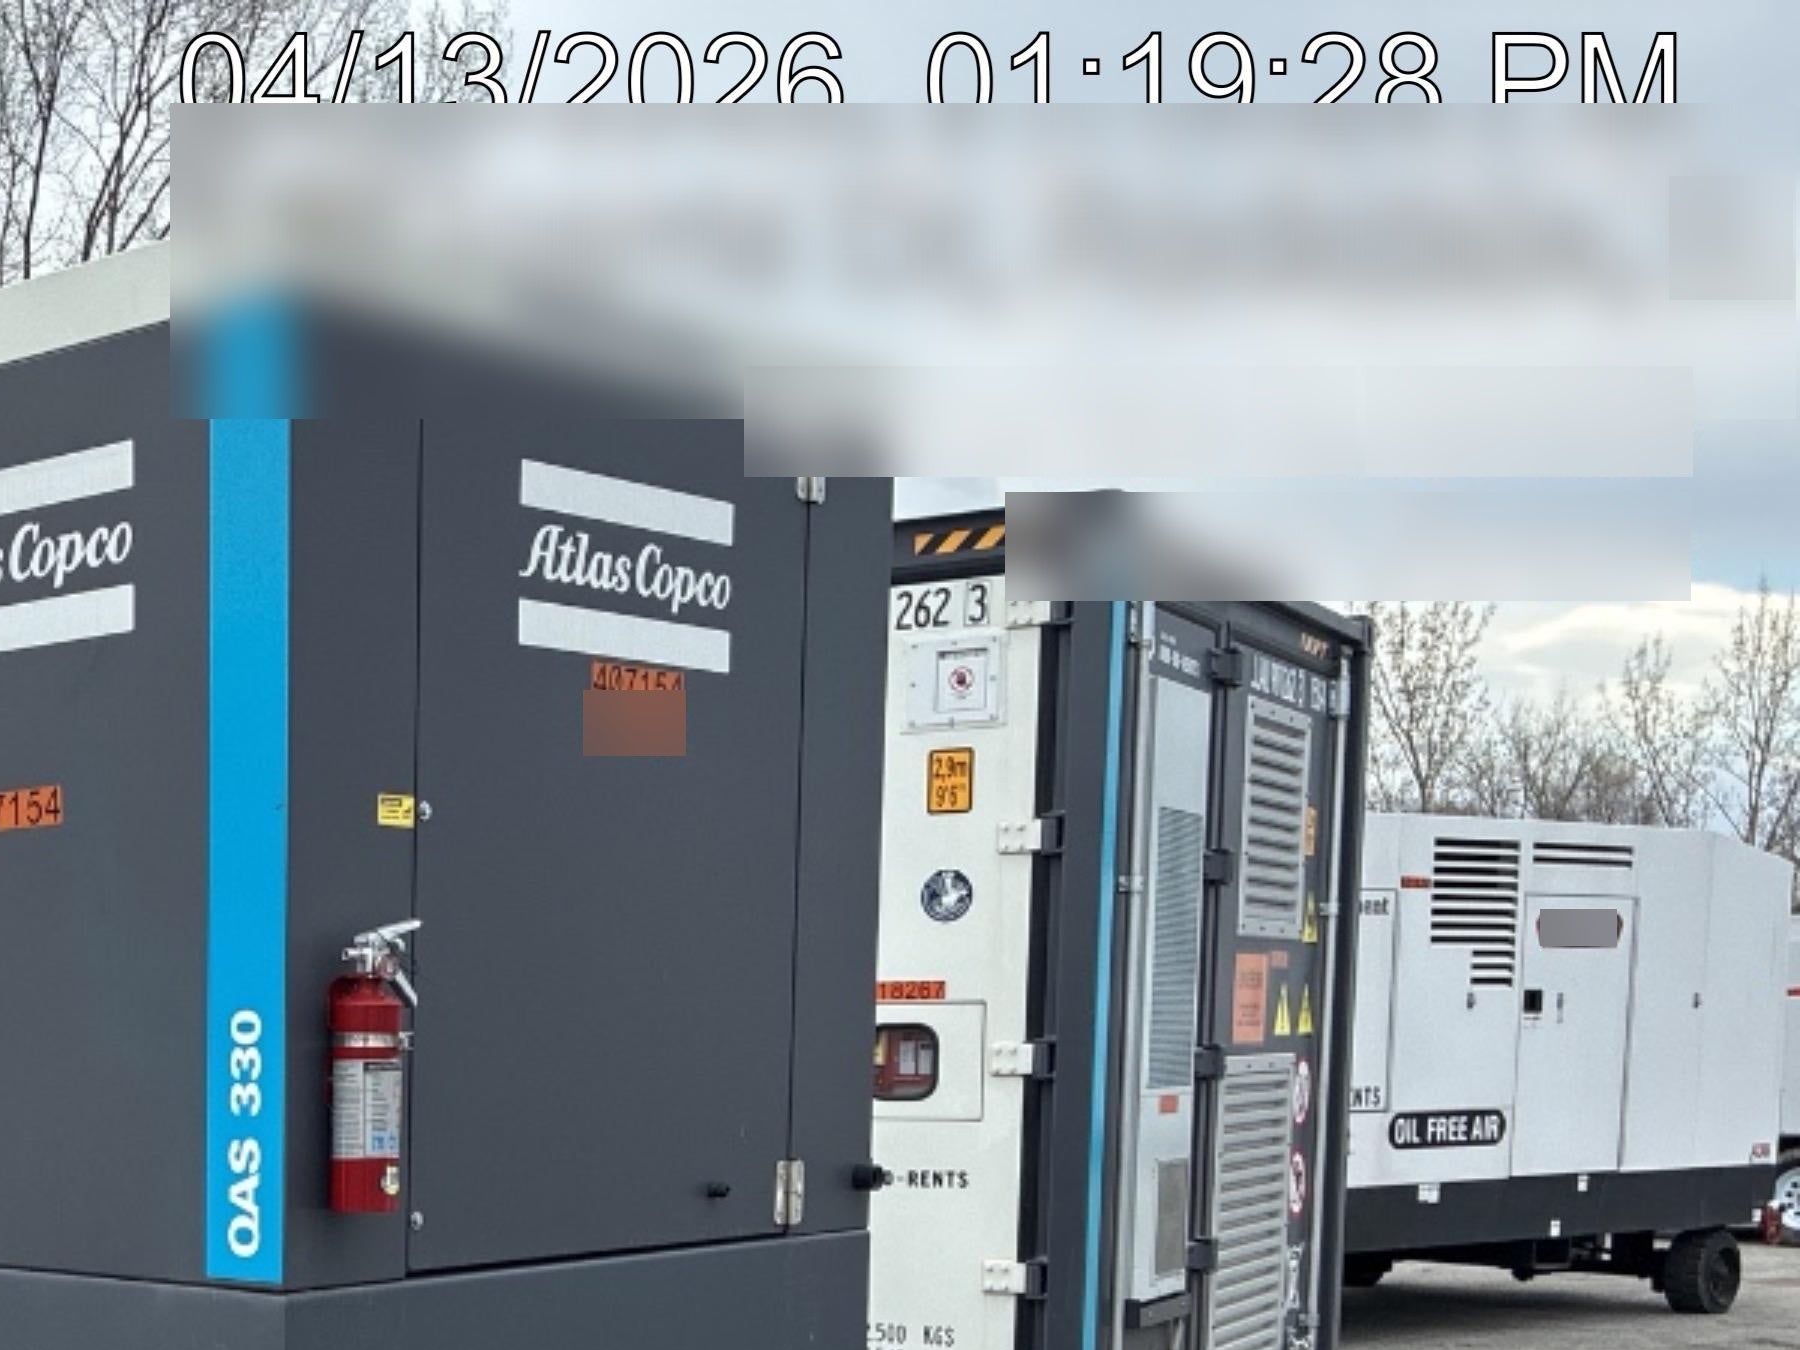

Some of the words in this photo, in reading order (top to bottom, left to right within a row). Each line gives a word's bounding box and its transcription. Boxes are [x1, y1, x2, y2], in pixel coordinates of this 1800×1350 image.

[9, 521, 133, 589] Copco
[518, 524, 632, 594] Atlas
[635, 542, 732, 615] Copco
[895, 587, 951, 630] 262
[967, 583, 988, 622] 3
[229, 1009, 263, 1117] 330
[1394, 1117, 1421, 1144] OIL
[1426, 1115, 1469, 1143] FREE
[1470, 1114, 1501, 1142] AIR
[227, 1137, 262, 1258] QAS
[923, 1325, 955, 1347] KGS
